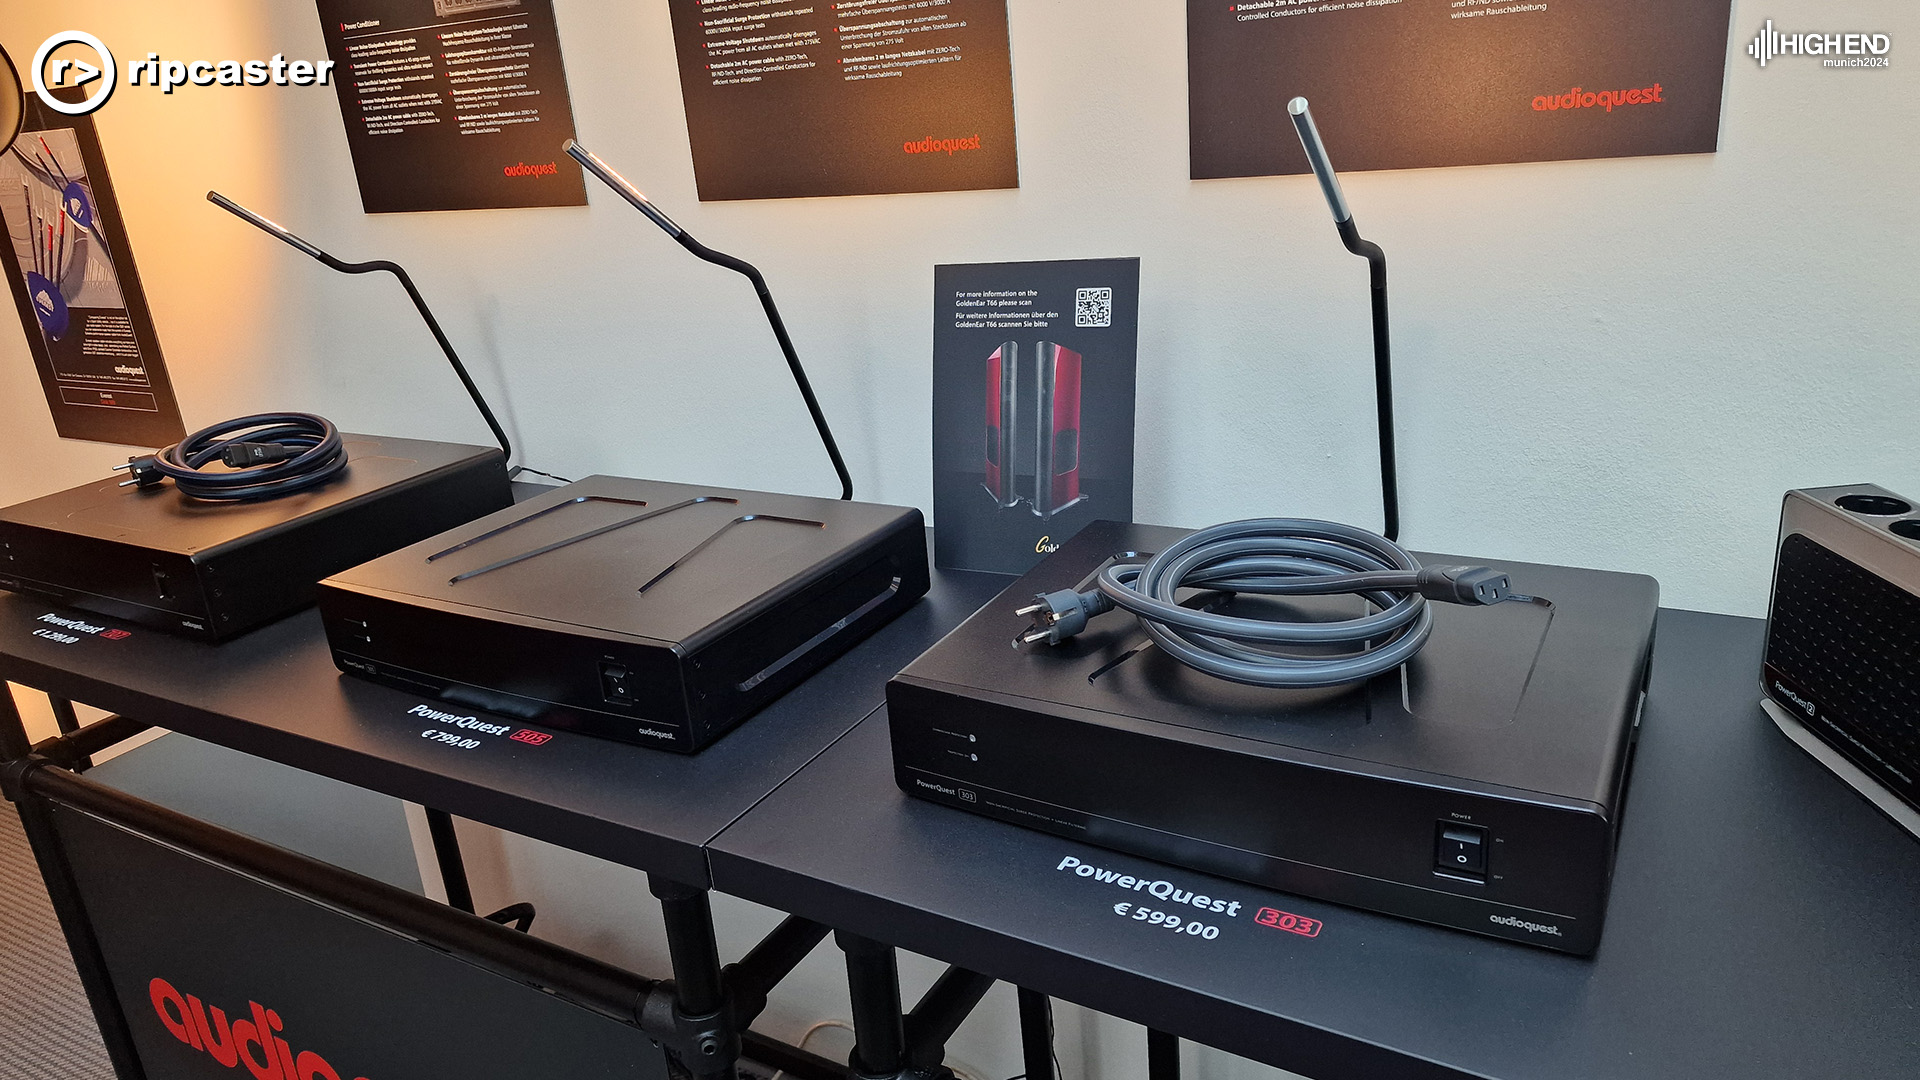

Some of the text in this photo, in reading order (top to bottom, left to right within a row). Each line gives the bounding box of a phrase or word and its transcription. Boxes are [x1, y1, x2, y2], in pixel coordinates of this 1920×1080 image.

[794, 7, 814, 15] repeated
[1237, 1, 1274, 11] Detachable
[1237, 12, 1269, 21] Controlled
[1270, 9, 1306, 17] Conductors
[1318, 3, 1345, 12] efficient
[1450, 4, 1547, 19] wirksame Rauschableitung
[914, 14, 948, 23] automatischen
[707, 40, 742, 48] Extreme-Voltage
[765, 33, 792, 41] automatically
[882, 28, 910, 36] Stromzufuhr
[902, 49, 926, 57] Netzkabel
[1532, 83, 1662, 113] audioquest
[903, 134, 981, 156] audioquest
[504, 162, 557, 178] audioquest
[36, 612, 105, 634] PowerQuest
[407, 704, 547, 745] PowerQuest 505
[421, 728, 480, 750] € 799,00
[916, 778, 956, 796] PowerQuest
[1056, 856, 1315, 935] PowerQuest 303
[1113, 902, 1220, 940] € 599,00
